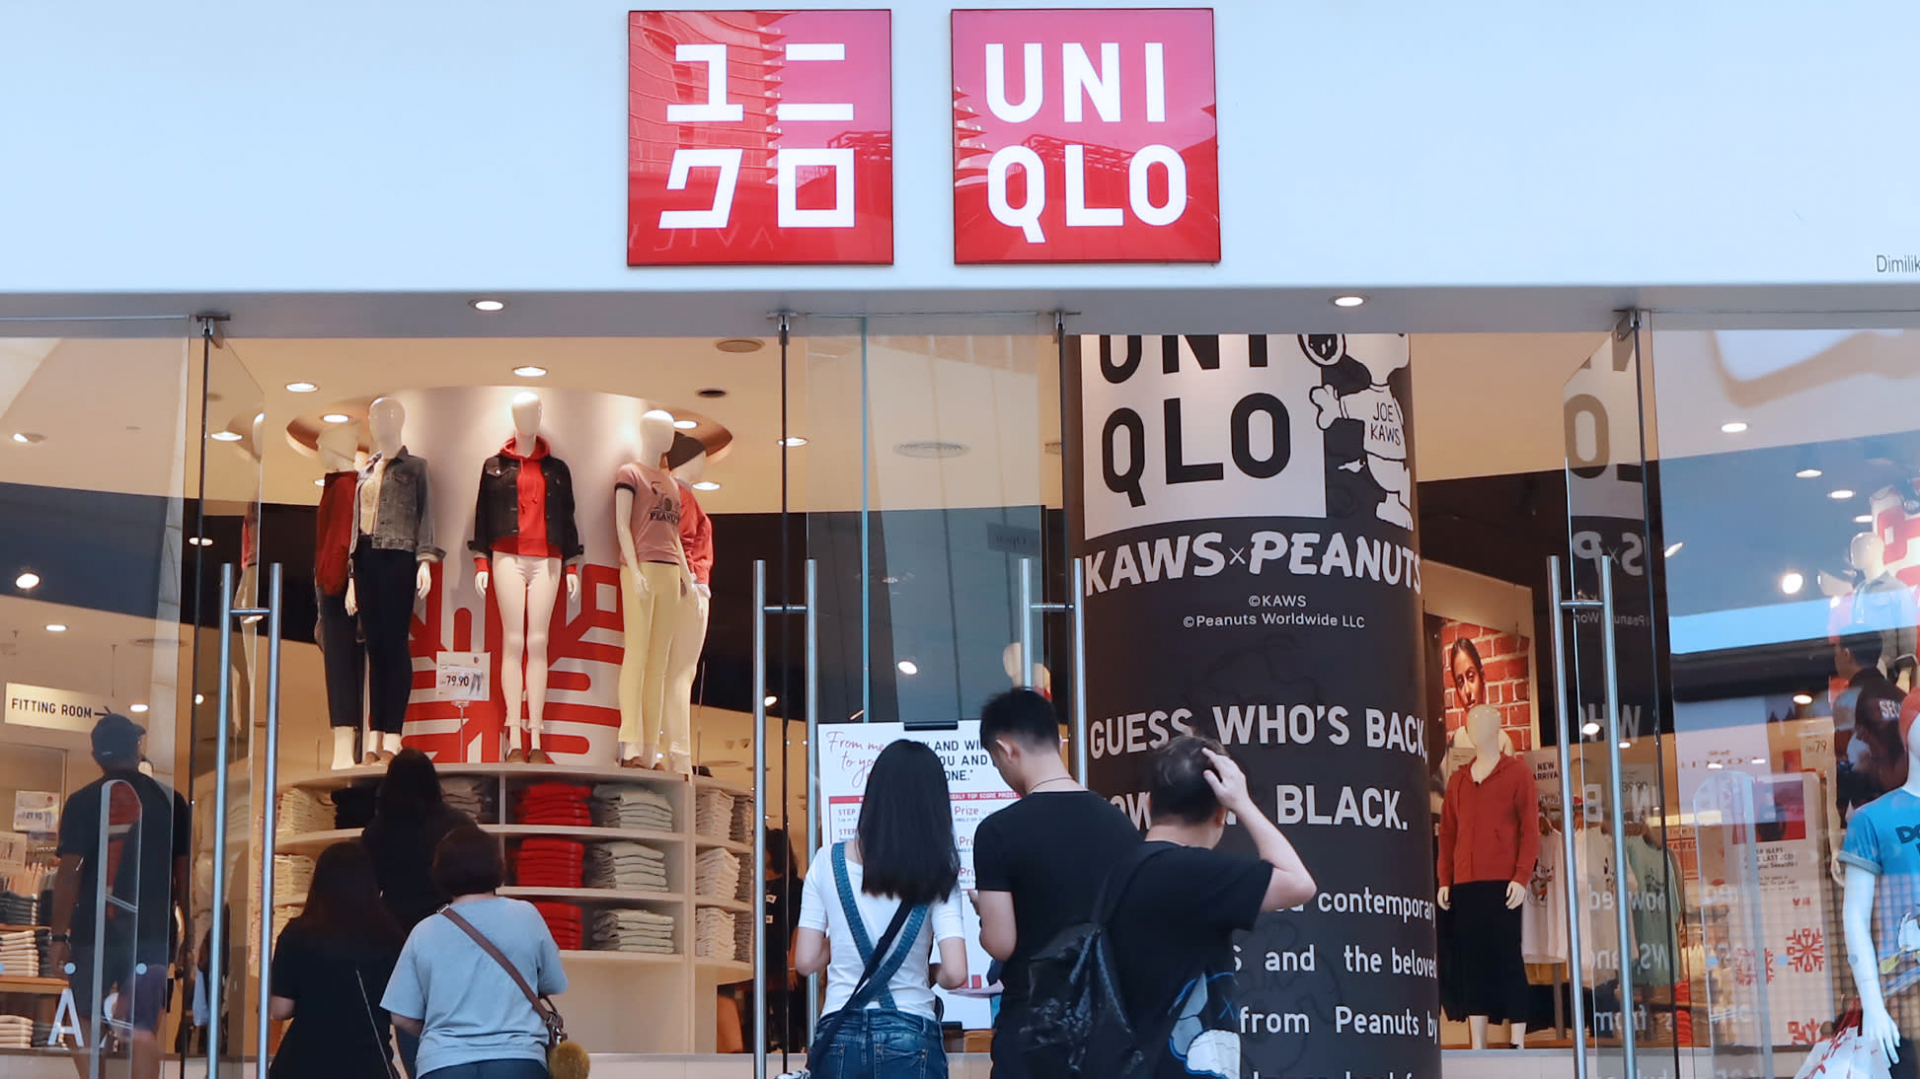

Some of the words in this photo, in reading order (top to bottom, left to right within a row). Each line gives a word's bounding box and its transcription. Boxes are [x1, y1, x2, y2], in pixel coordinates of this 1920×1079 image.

[667, 43, 854, 122] ユニ
[985, 42, 1165, 123] UNI
[659, 148, 855, 229] クロ
[987, 145, 1187, 243] QLO
[1373, 402, 1393, 422] JOE
[1371, 424, 1401, 446] KAWS
[1102, 392, 1291, 507] QLO
[1085, 532, 1226, 597] KAWS
[1248, 530, 1422, 595] PEANUTS
[1261, 612, 1338, 626] Worldwide
[1342, 615, 1366, 628] LLC
[12, 697, 57, 715] FITTING
[61, 703, 92, 718] ROOM
[826, 731, 863, 753] From
[934, 740, 959, 751] AND
[964, 739, 985, 751] WI
[1090, 708, 1194, 759] GUESS
[1212, 705, 1350, 745] WHO'S
[1365, 708, 1428, 765] BACK,
[940, 756, 955, 766] OU
[961, 755, 988, 766] AND
[1537, 762, 1555, 770] NEW
[851, 758, 877, 788] yo
[1533, 772, 1560, 780] ARRIVA
[838, 808, 856, 816] STEP
[954, 805, 979, 816] Prize
[1276, 784, 1408, 830] BLACK.
[959, 835, 974, 846] Pri
[959, 867, 975, 877] Pri
[1264, 944, 1315, 972] and
[1343, 944, 1383, 973] the
[1391, 946, 1438, 979] beloved
[1239, 1005, 1310, 1034] from
[1335, 1006, 1420, 1036] Peanuts
[1426, 1010, 1438, 1044] by
